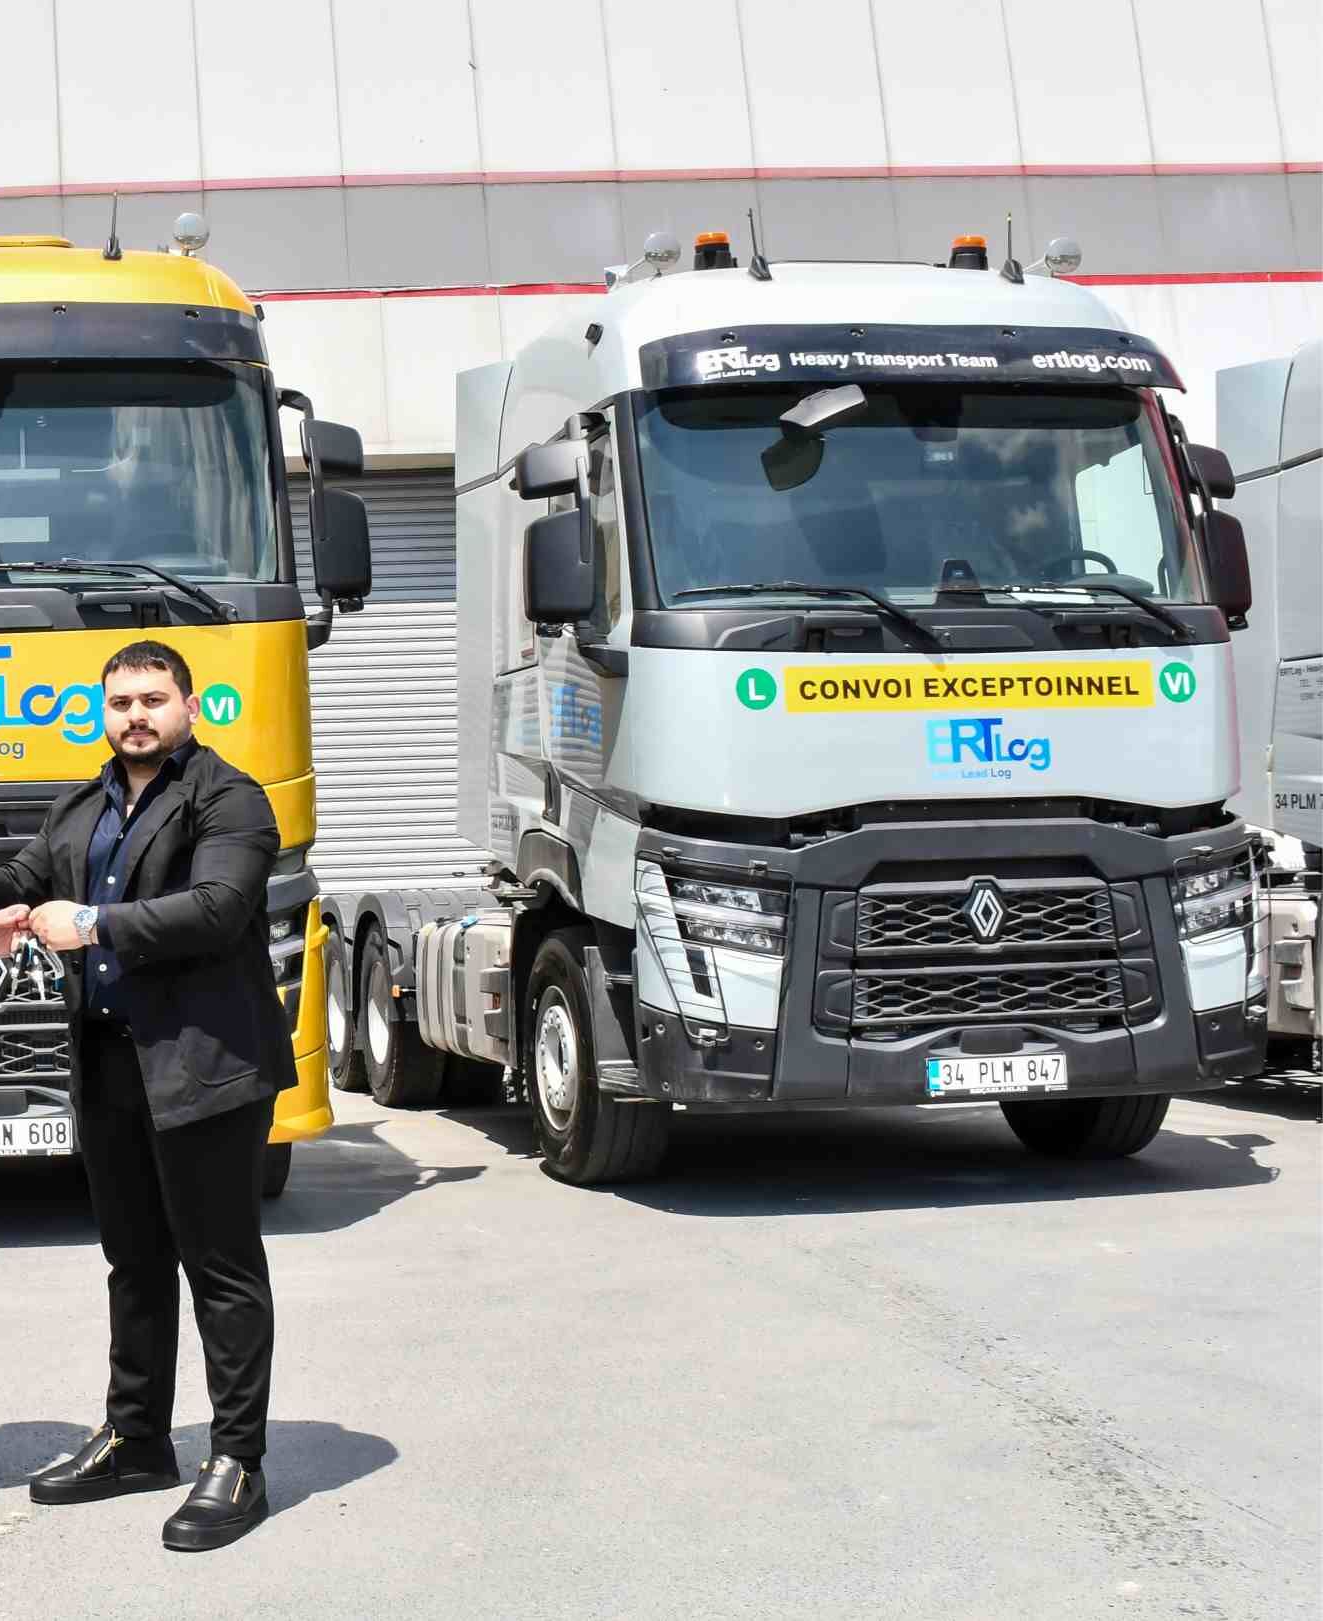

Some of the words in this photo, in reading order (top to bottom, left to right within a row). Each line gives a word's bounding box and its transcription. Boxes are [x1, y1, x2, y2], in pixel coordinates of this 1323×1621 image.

[789, 352, 849, 368] Heavy
[852, 352, 945, 368] Transport
[946, 353, 998, 368] Team
[1032, 351, 1152, 373] ertlog.com
[748, 678, 767, 701] L
[799, 678, 912, 701] CONVOI
[924, 675, 1140, 698] EXCEPTOINNEL
[1164, 671, 1190, 696] VI
[207, 697, 235, 721] VI
[926, 717, 1051, 771] ERTLog
[990, 768, 1012, 780] Log
[1275, 793, 1287, 809] 34
[1291, 793, 1316, 810] PLM
[942, 1063, 964, 1085] 34
[979, 1061, 1014, 1083] PLM
[1028, 1058, 1061, 1081] 847
[29, 1122, 67, 1145] 608
